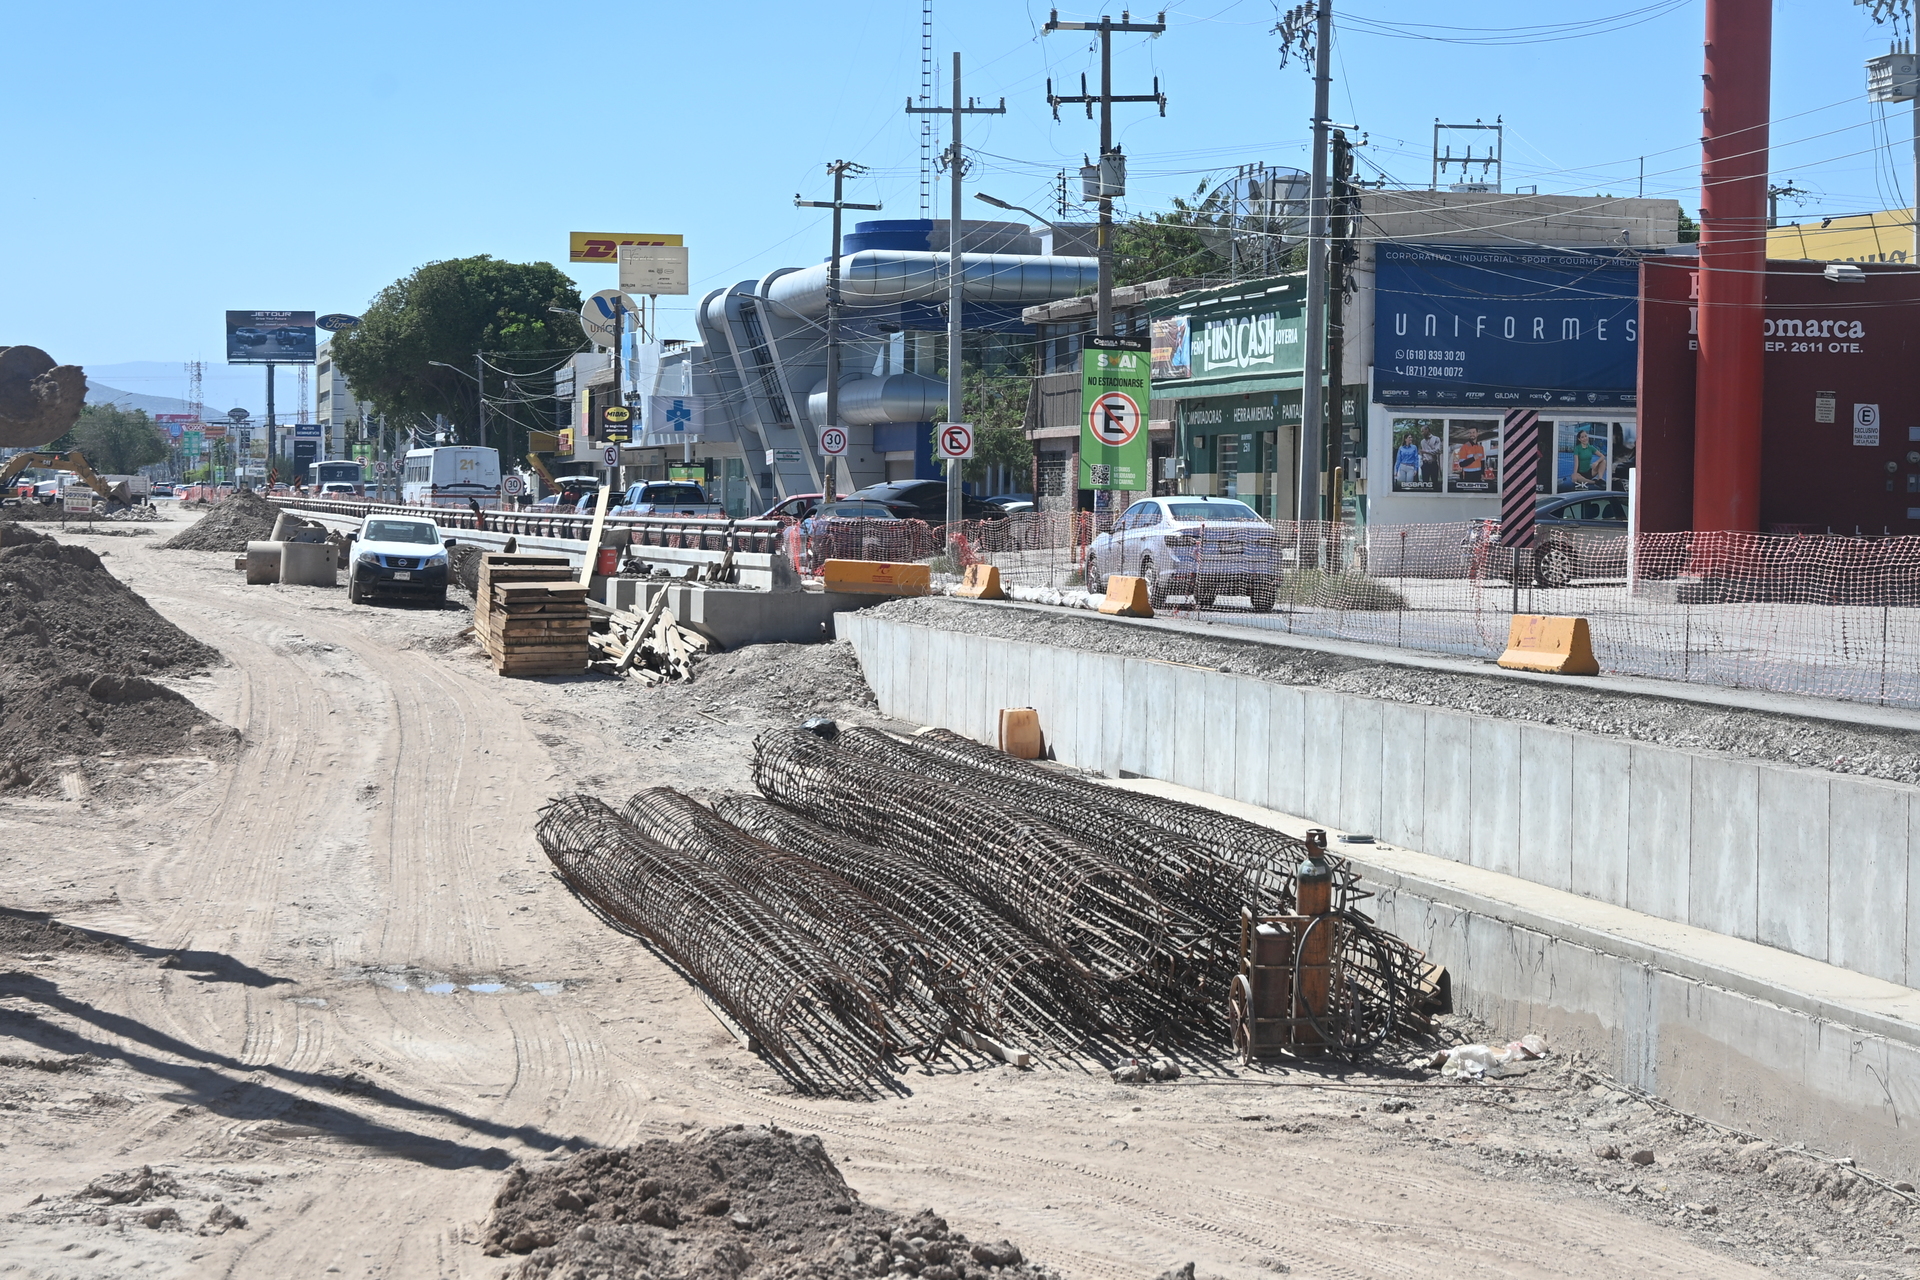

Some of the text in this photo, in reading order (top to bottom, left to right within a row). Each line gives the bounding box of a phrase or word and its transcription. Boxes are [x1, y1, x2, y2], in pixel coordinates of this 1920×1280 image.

[1385, 252, 1451, 261] CORPORATIVO
[1459, 254, 1514, 263] INDUSTRIAL
[1521, 256, 1551, 264] SPORT
[1559, 257, 1604, 265] GOURMET
[1395, 313, 1637, 342] UNIFORMES
[1204, 312, 1275, 372] FIRST CASH
[1790, 342, 1823, 353] 2611
[1828, 342, 1864, 353] OTE.
[1406, 349, 1465, 361] (618) 839 30 20
[1406, 365, 1463, 377] (871) 204 0072
[1088, 376, 1144, 388] NO ESTACIONARSE
[1183, 409, 1223, 427] COMPUTADORAS
[1233, 405, 1274, 423] HERRAMIENTAS
[1862, 409, 1871, 423] E
[827, 434, 841, 445] 30
[460, 459, 474, 470] 21
[508, 480, 517, 488] 30
